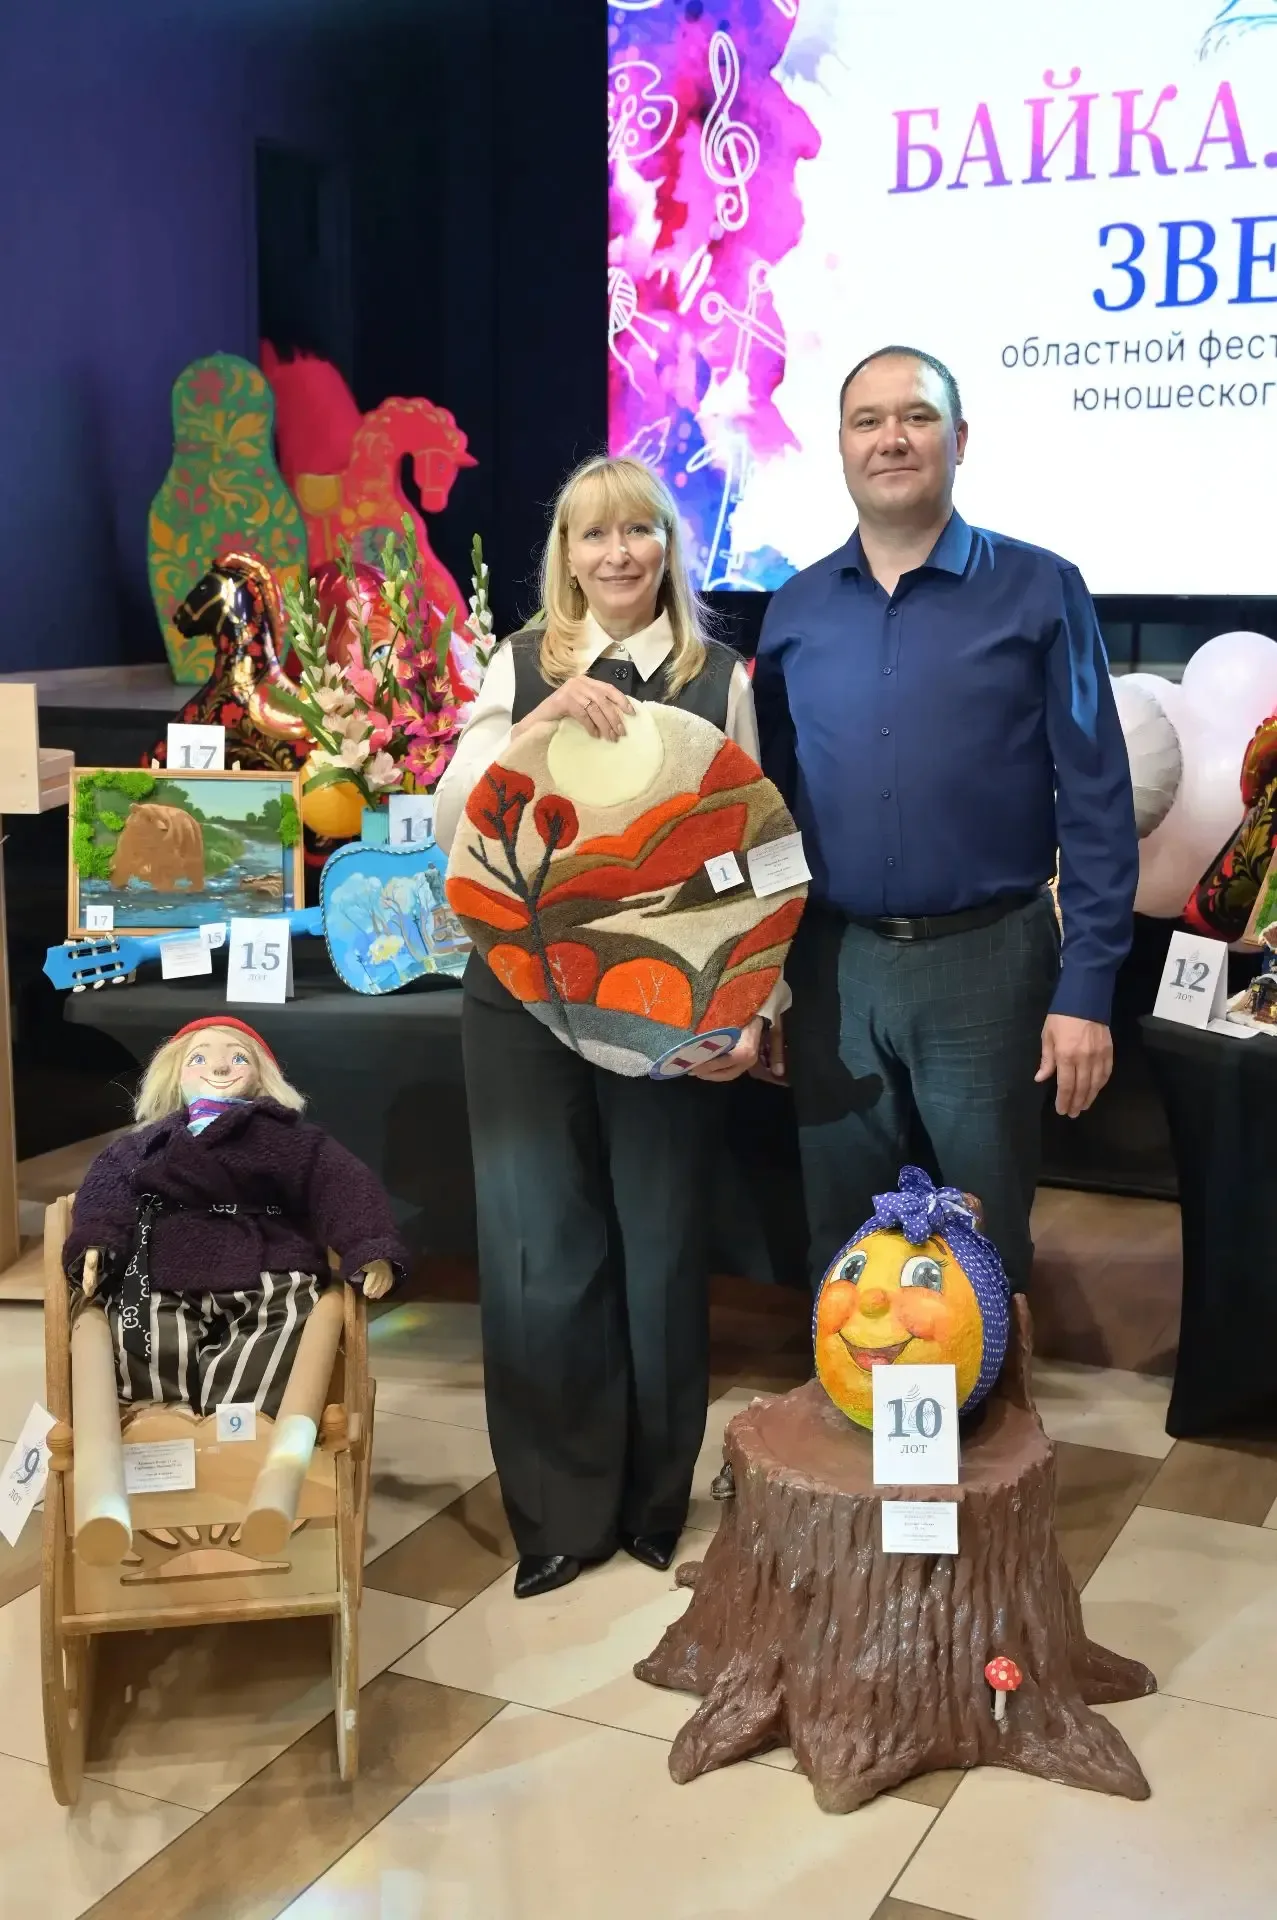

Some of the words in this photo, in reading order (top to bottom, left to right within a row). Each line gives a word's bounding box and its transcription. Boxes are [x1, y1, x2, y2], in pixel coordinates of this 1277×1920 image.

[887, 66, 1277, 194] БАЙКА
[1093, 215, 1277, 312] ЗВЕ
[1002, 331, 1185, 368] областной
[1073, 381, 1276, 411] юношеског
[180, 745, 217, 769] 17
[401, 817, 433, 843] 11
[720, 866, 730, 882] 1
[94, 915, 108, 926] 17
[208, 932, 222, 944] 15
[241, 942, 281, 971] 15
[1169, 958, 1210, 993] 12
[230, 1416, 242, 1433] 9
[887, 1397, 942, 1438] 10
[17, 1447, 40, 1484] 9
